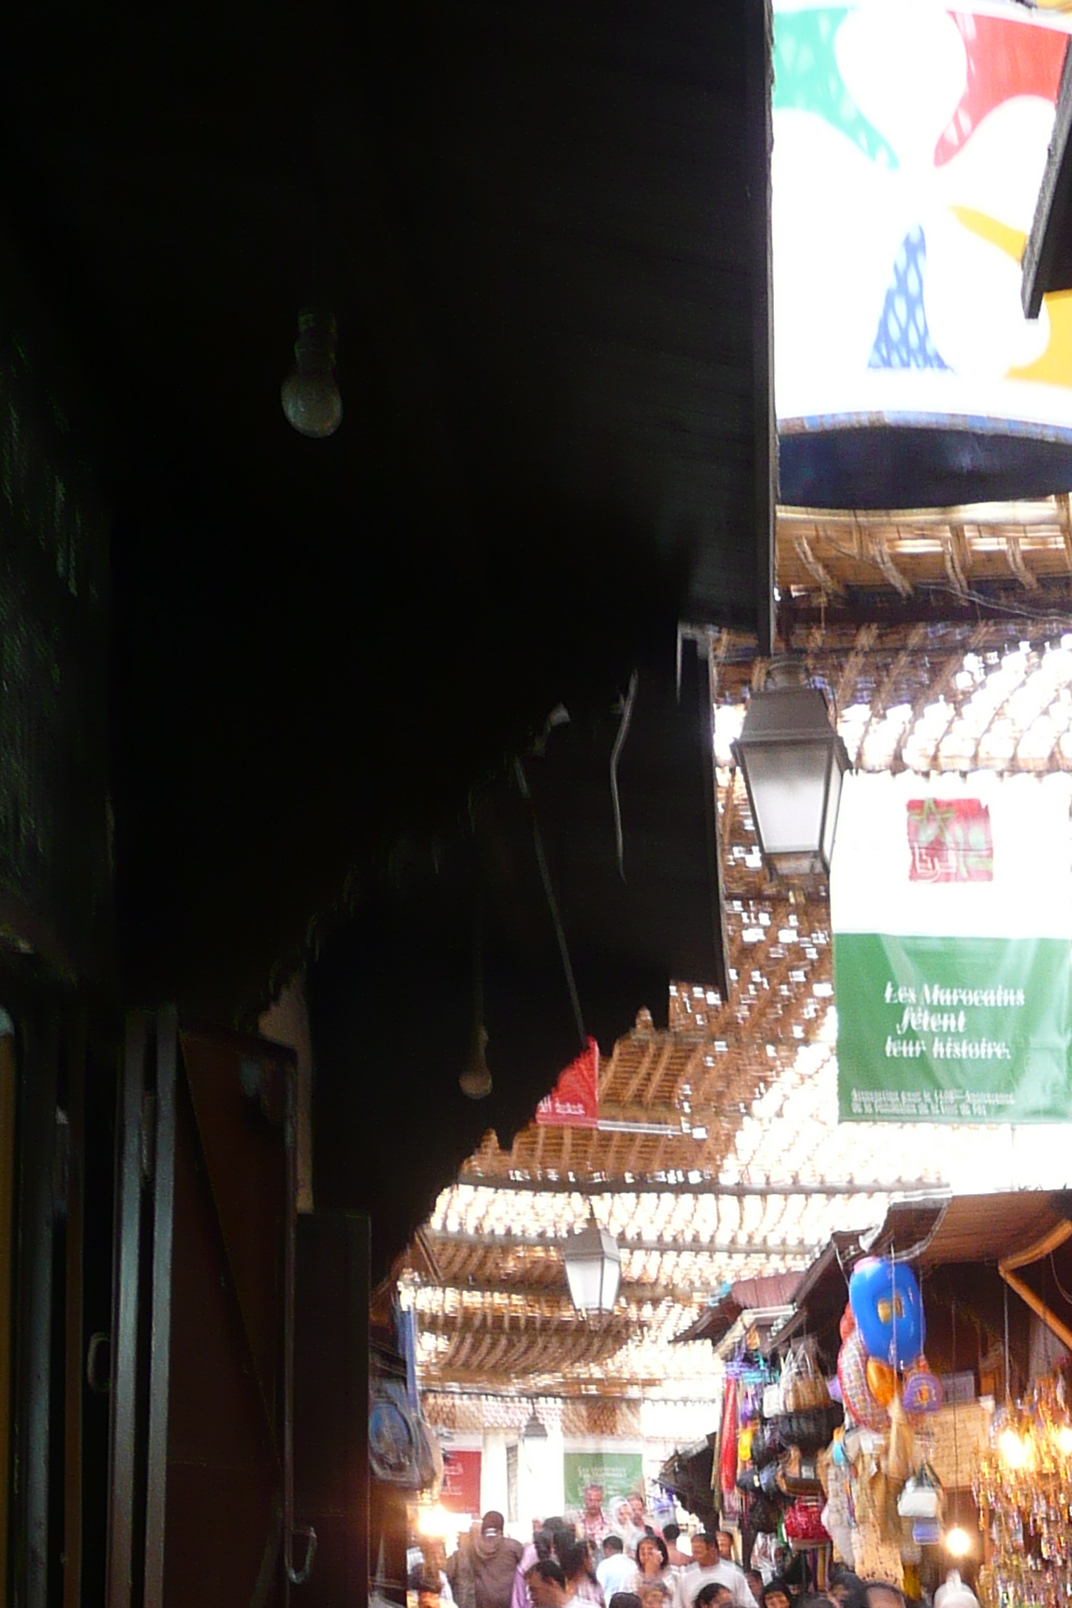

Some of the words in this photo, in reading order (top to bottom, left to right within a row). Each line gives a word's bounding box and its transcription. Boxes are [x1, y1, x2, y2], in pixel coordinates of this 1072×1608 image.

[884, 981, 917, 1004] Les
[923, 983, 1025, 1007] Marocains
[896, 1006, 966, 1035] fêtent
[885, 1035, 926, 1058] leur
[932, 1036, 1012, 1060] histoire.
